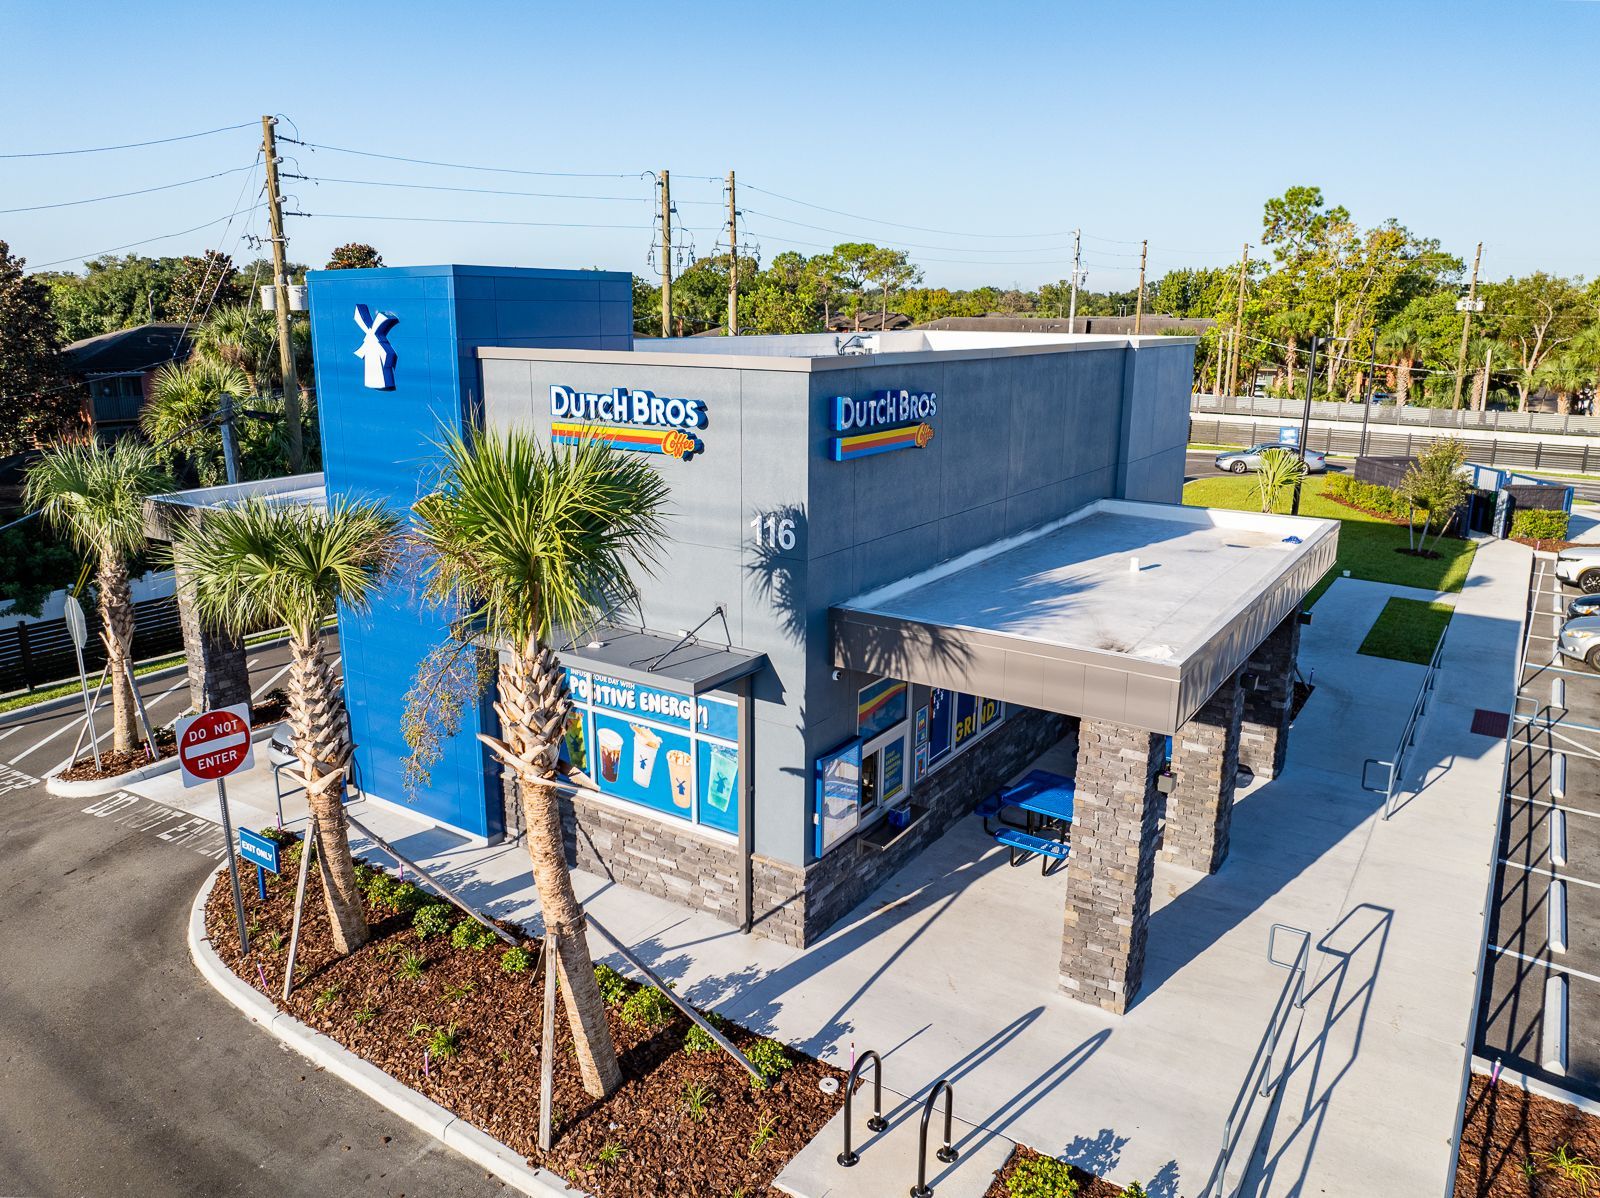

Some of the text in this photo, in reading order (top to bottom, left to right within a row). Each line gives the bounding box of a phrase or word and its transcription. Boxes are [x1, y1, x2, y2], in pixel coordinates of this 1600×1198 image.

[550, 385, 699, 427] DUTCH BROS
[841, 389, 937, 430] DUTCH BROS
[662, 429, 695, 459] Coffee
[750, 515, 796, 550] 116
[620, 680, 635, 689] WITH
[189, 719, 238, 743] DO NOT
[198, 750, 238, 771] ENTER
[81, 791, 140, 818] DO
[241, 839, 273, 862] EXIT ONLY
